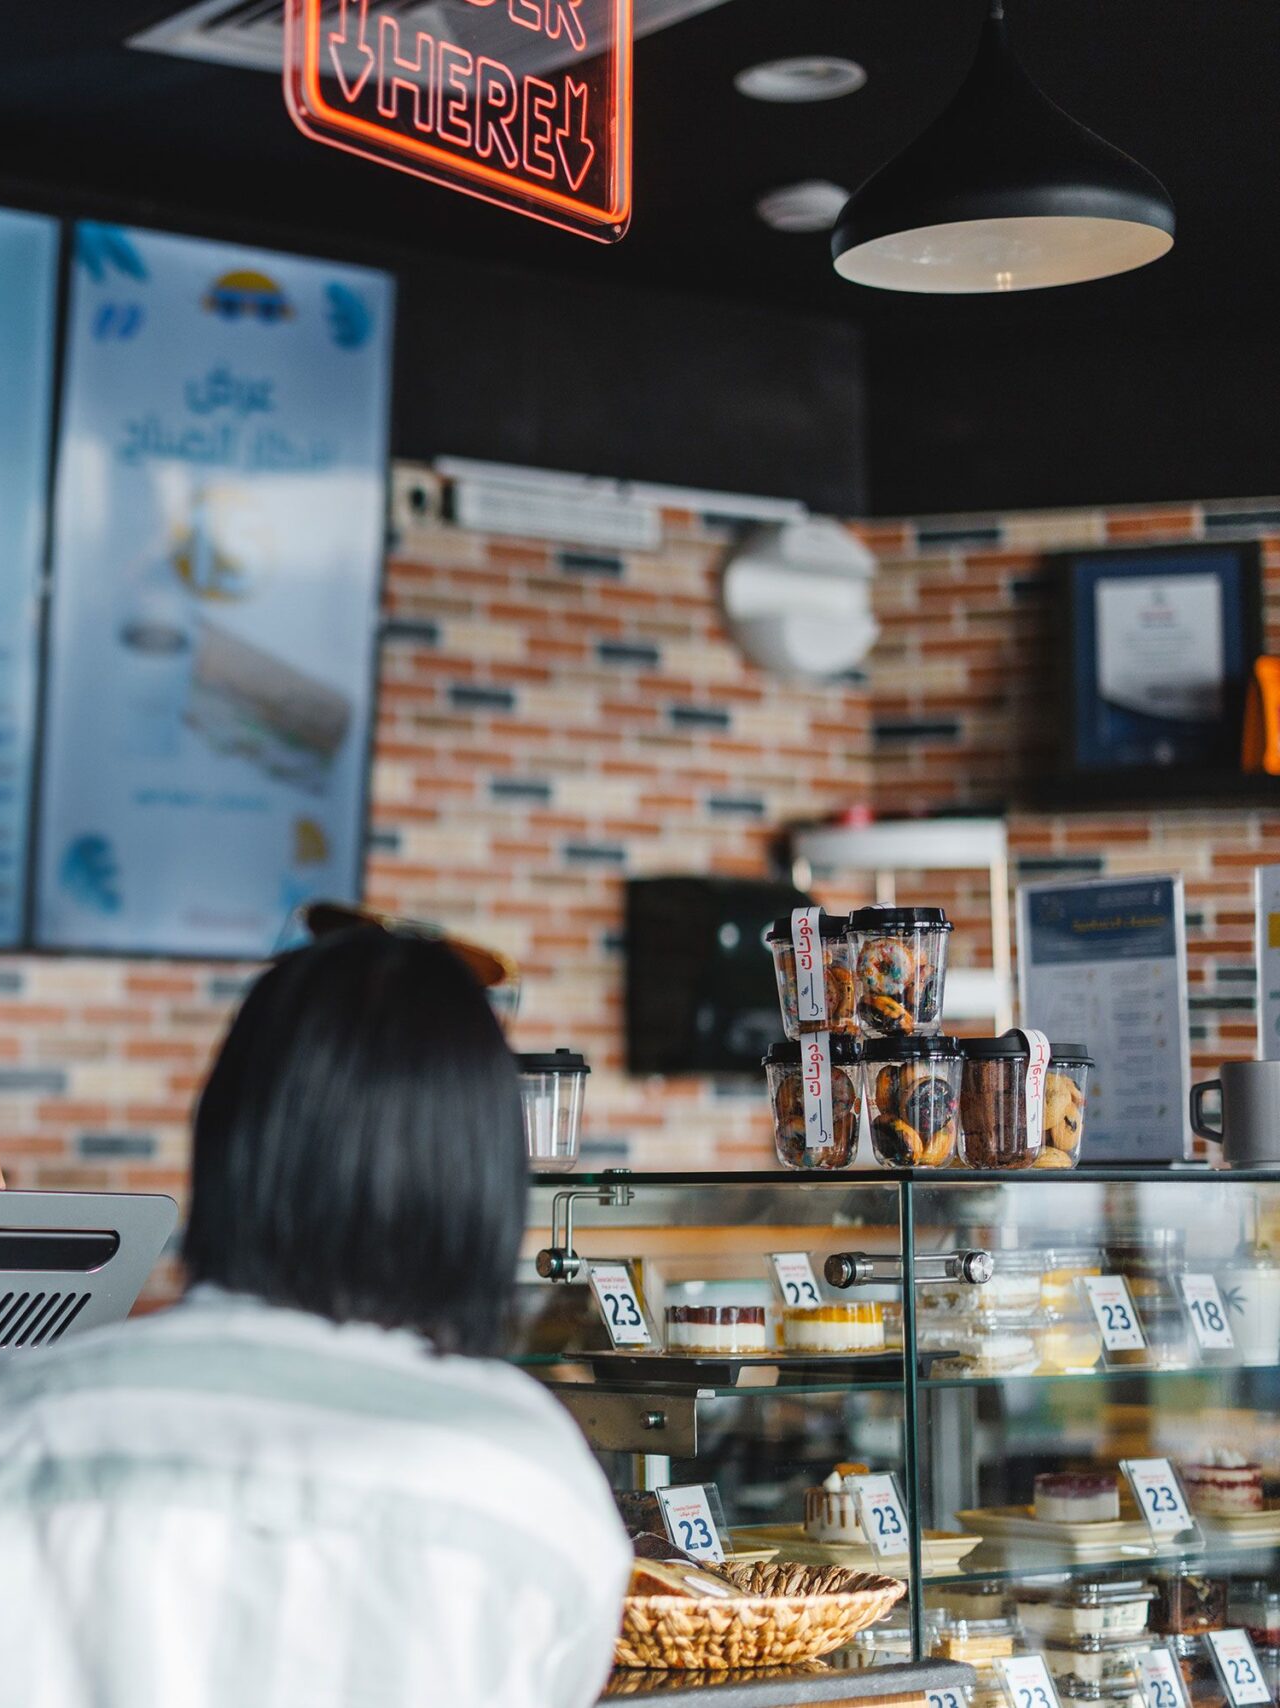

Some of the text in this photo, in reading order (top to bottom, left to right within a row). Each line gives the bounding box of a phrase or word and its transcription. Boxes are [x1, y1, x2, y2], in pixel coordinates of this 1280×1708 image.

[377, 15, 557, 180] HERE
[797, 917, 813, 970] دونات
[805, 1044, 824, 1097] دونات
[786, 1281, 819, 1304] 23
[603, 1293, 641, 1326] 23
[1102, 1304, 1131, 1330] 23
[1191, 1300, 1225, 1331] 18
[1145, 1486, 1178, 1511] 23
[678, 1517, 713, 1550] 23
[872, 1505, 902, 1535] 23
[1228, 1659, 1256, 1684] 23
[1019, 1686, 1051, 1708] 23
[1150, 1680, 1177, 1708] 23
